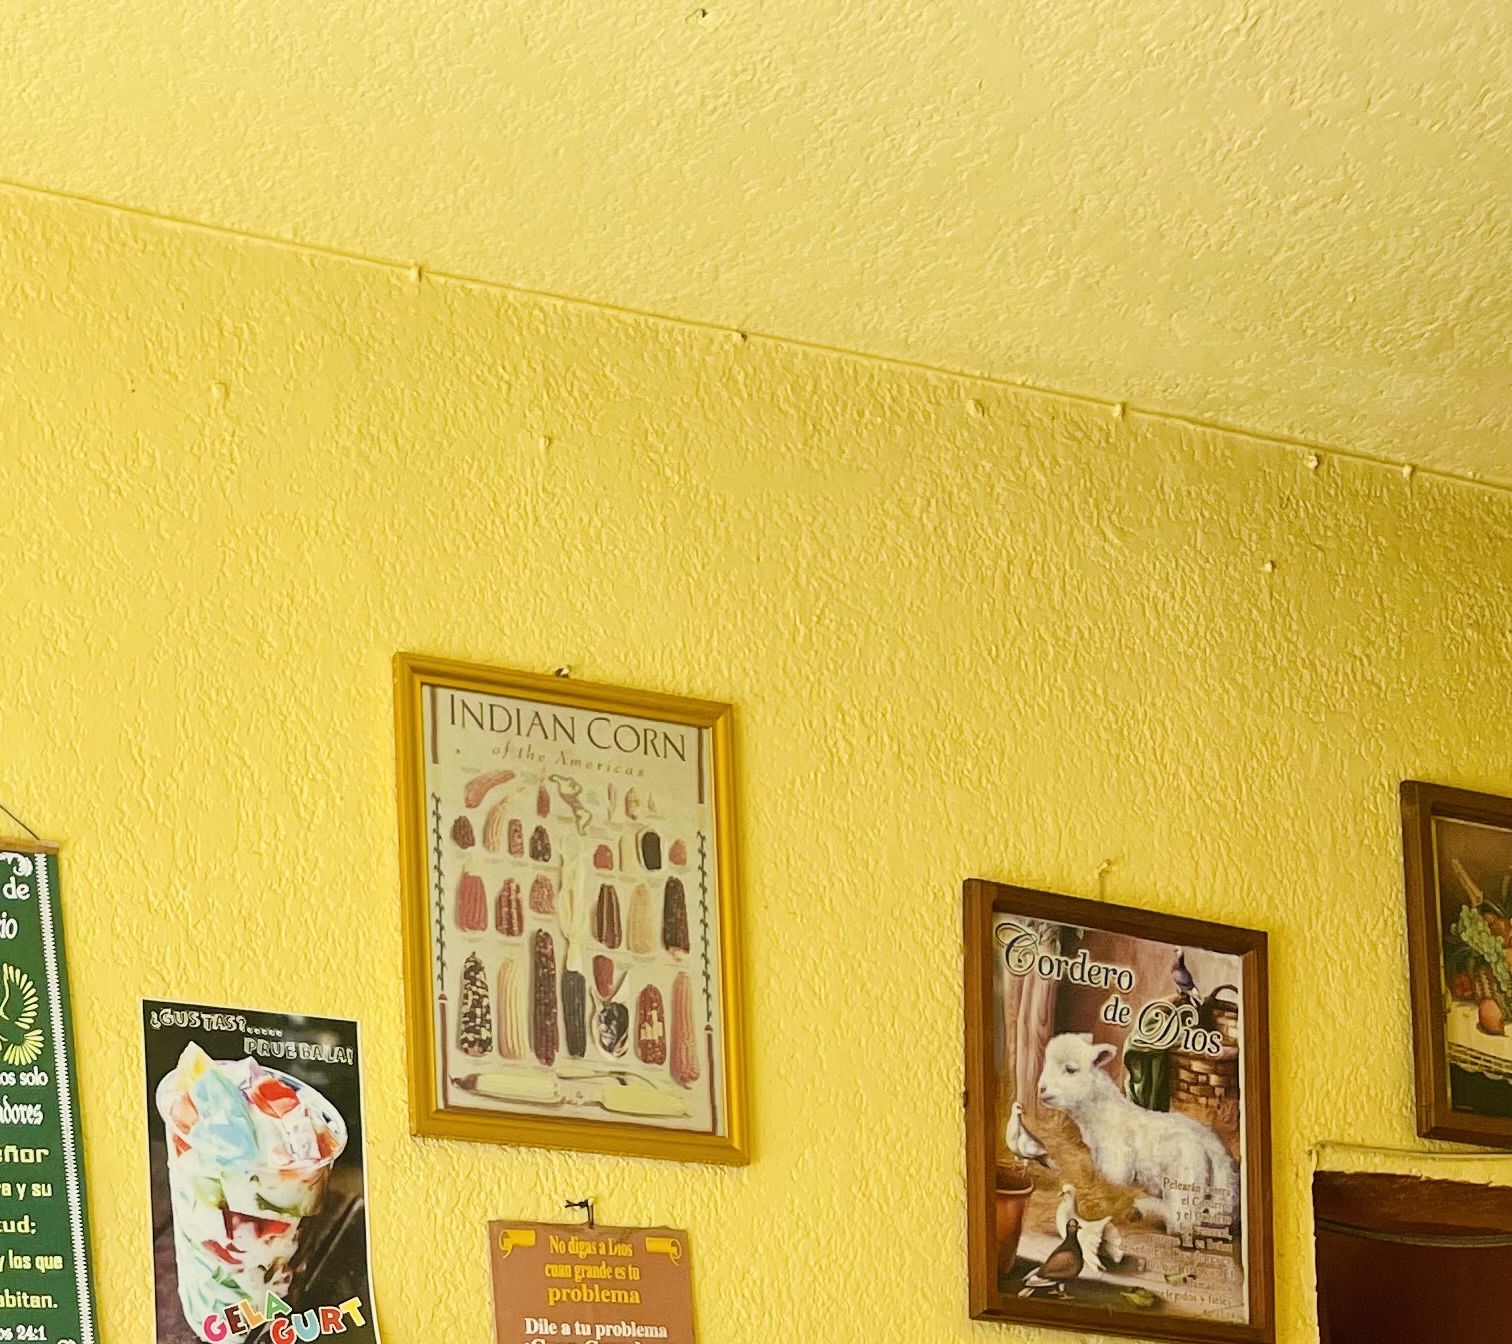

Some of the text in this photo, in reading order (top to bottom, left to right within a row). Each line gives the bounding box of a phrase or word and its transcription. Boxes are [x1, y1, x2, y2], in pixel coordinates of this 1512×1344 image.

[449, 694, 686, 762] INDIAN CORN
[492, 738, 646, 778] of the Americas
[2, 876, 30, 900] de
[995, 922, 1223, 1055] Cordero de Dios
[20, 1066, 48, 1086] solo
[16, 1183, 27, 1200] y
[32, 1183, 52, 1197] su
[549, 1236, 633, 1258] No digas a Dios
[9, 1252, 31, 1270] los
[35, 1255, 63, 1274] que
[545, 1261, 640, 1282] cuan grande es tu
[547, 1284, 641, 1305] problema
[16, 1325, 47, 1342] 24:1
[524, 1318, 668, 1340] Dile a tu problema
